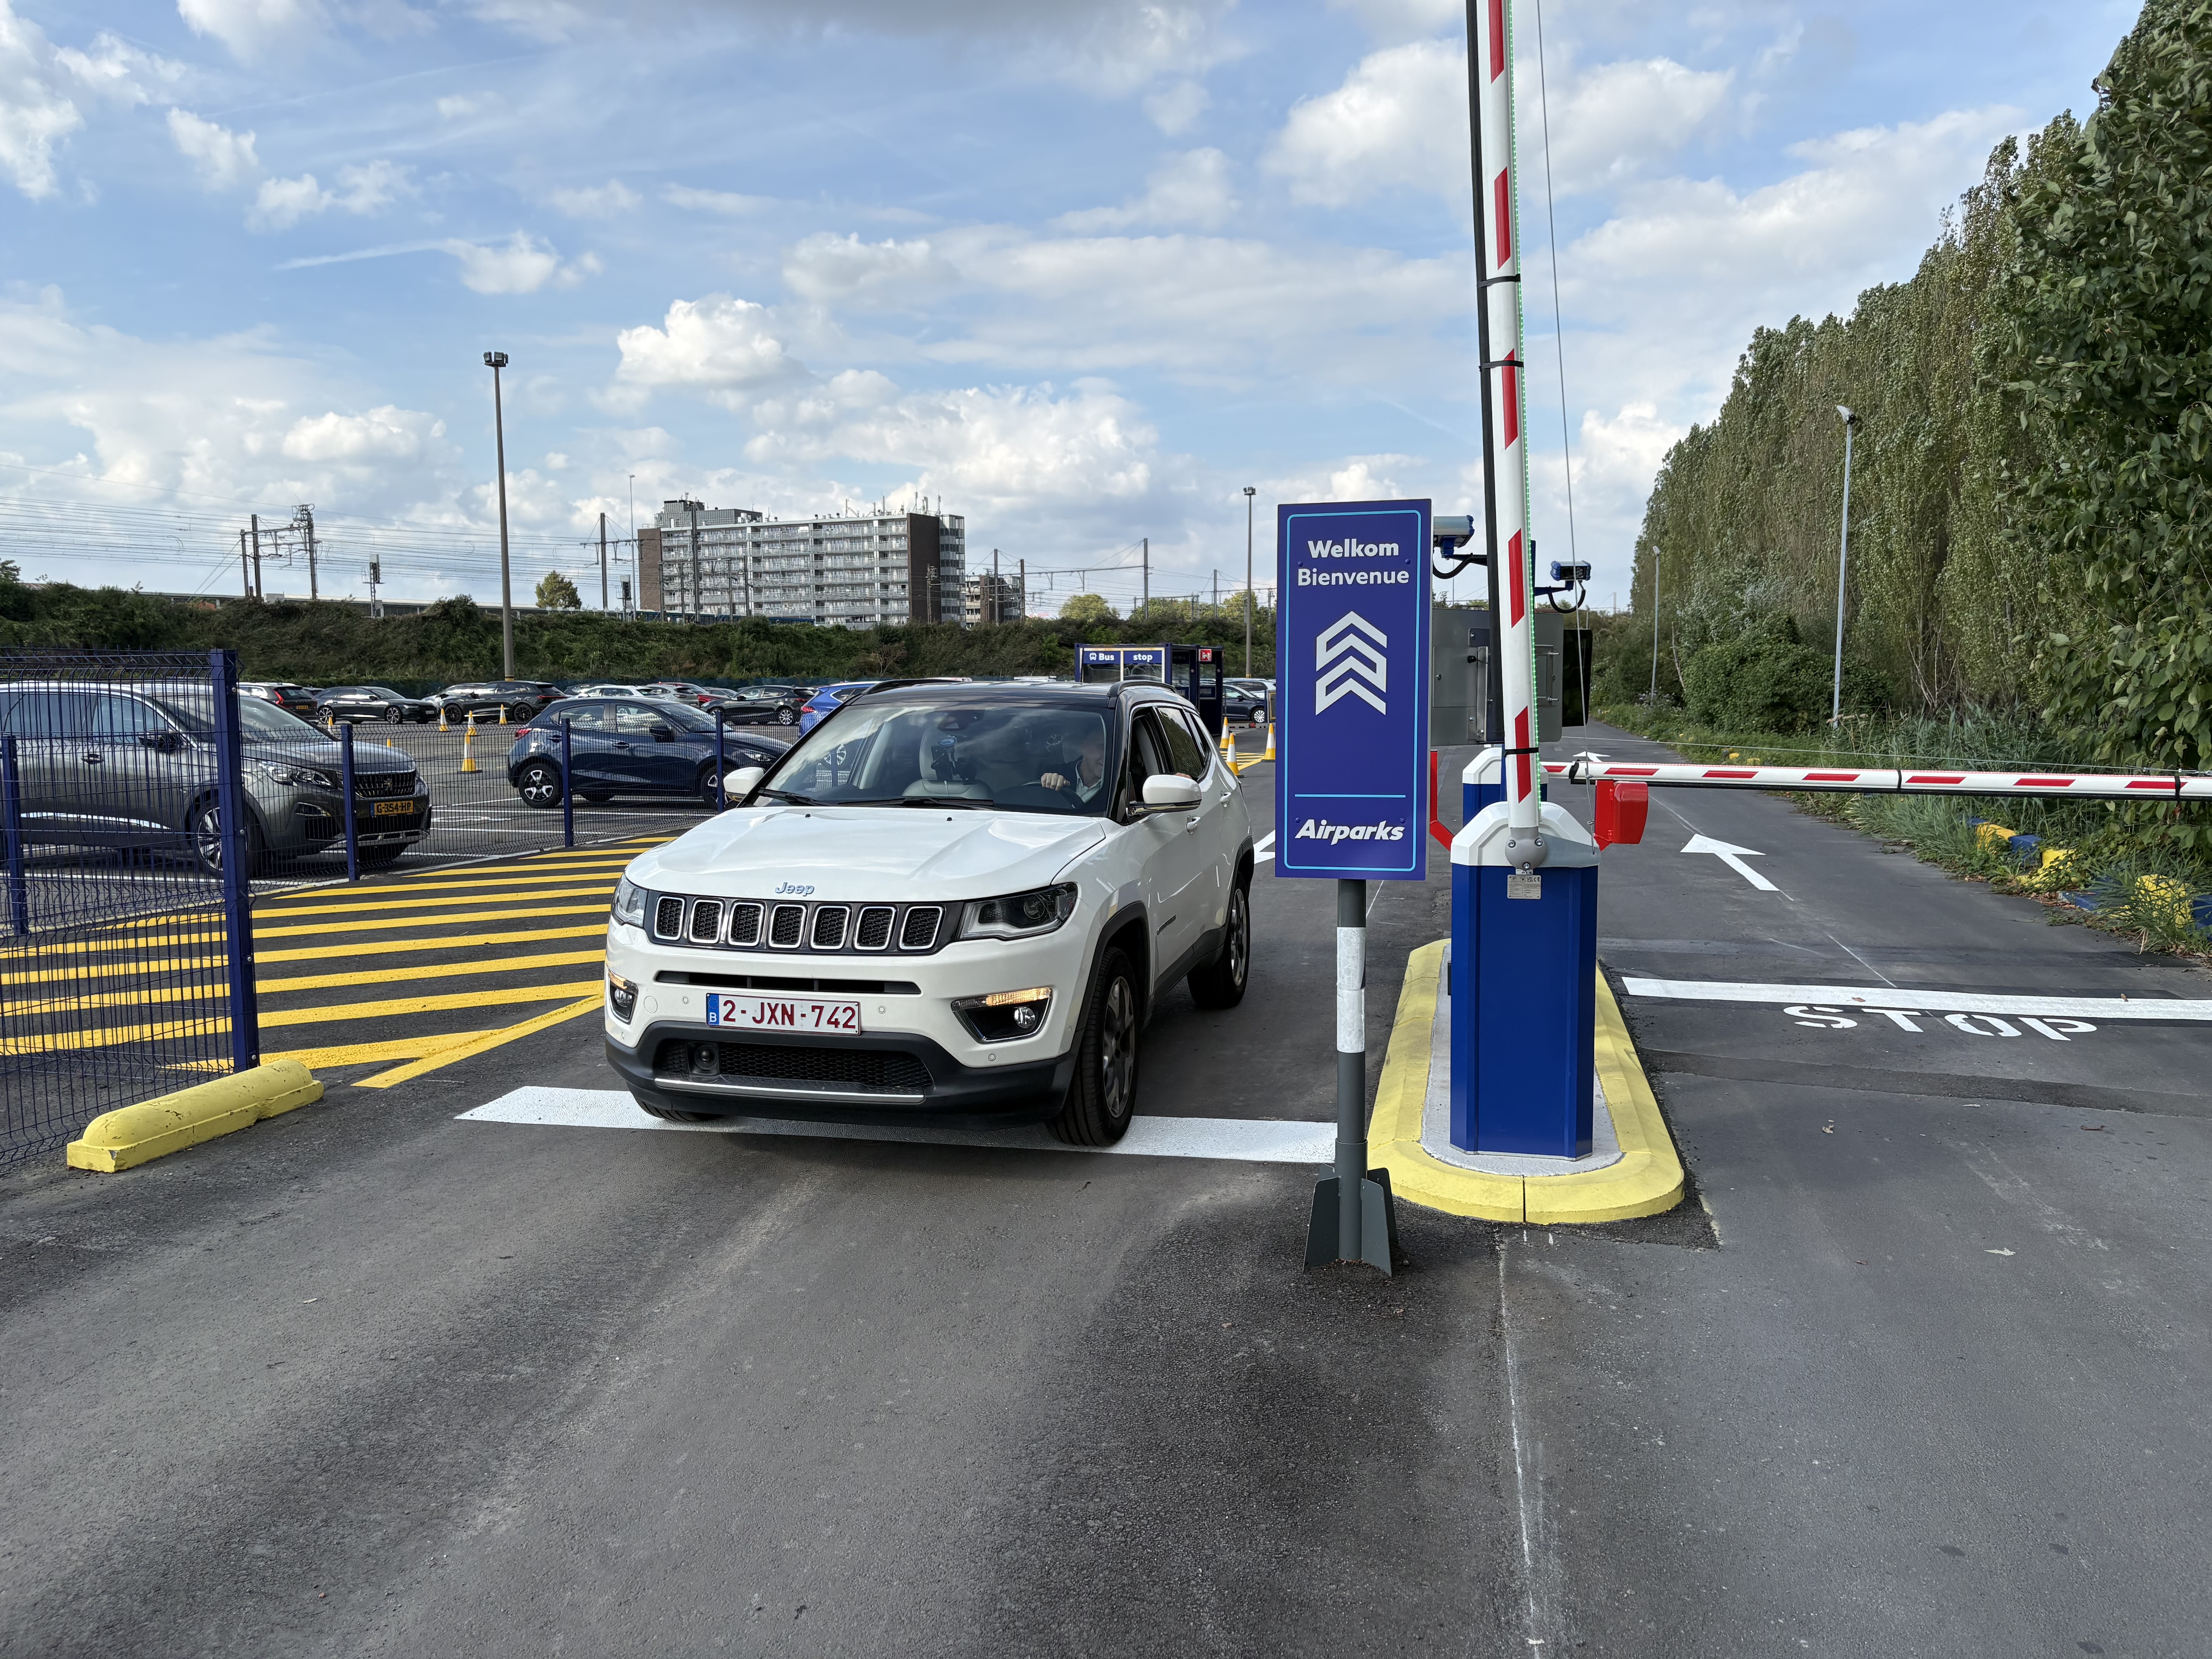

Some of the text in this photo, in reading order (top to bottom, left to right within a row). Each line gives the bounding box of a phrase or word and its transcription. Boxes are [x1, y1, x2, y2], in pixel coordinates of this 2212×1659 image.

[1307, 539, 1399, 558] Welkom
[1298, 568, 1409, 586] Bienvenue
[1133, 654, 1153, 662] stop
[1295, 819, 1405, 845] Airparks
[775, 882, 814, 896] Jeep
[709, 1000, 855, 1029] B 2-JXN-742
[1783, 1006, 2097, 1041] STOP
